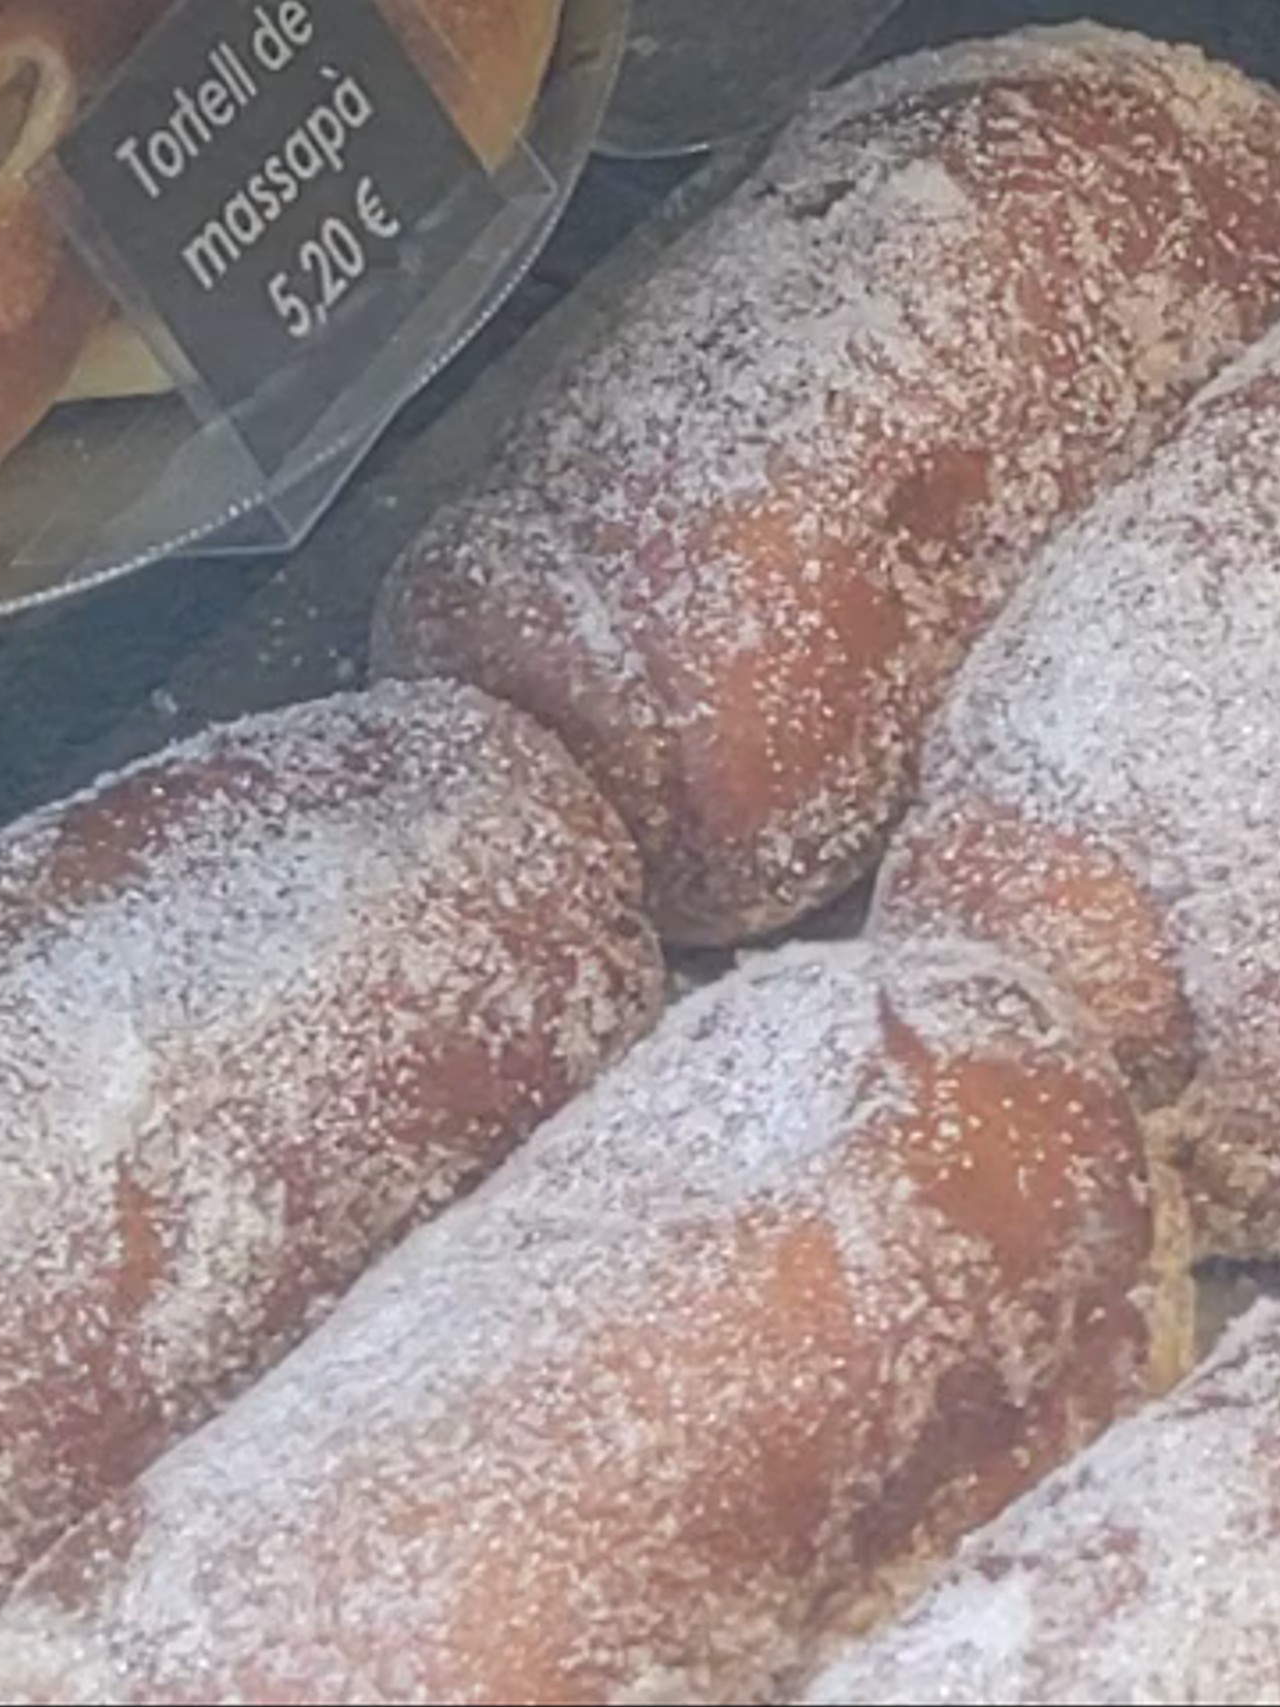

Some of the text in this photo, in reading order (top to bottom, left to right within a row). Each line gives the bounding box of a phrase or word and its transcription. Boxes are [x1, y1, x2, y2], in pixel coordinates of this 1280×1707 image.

[115, 41, 258, 199] Tortell
[180, 67, 375, 291] massapà
[267, 176, 402, 339] 5,20 €
